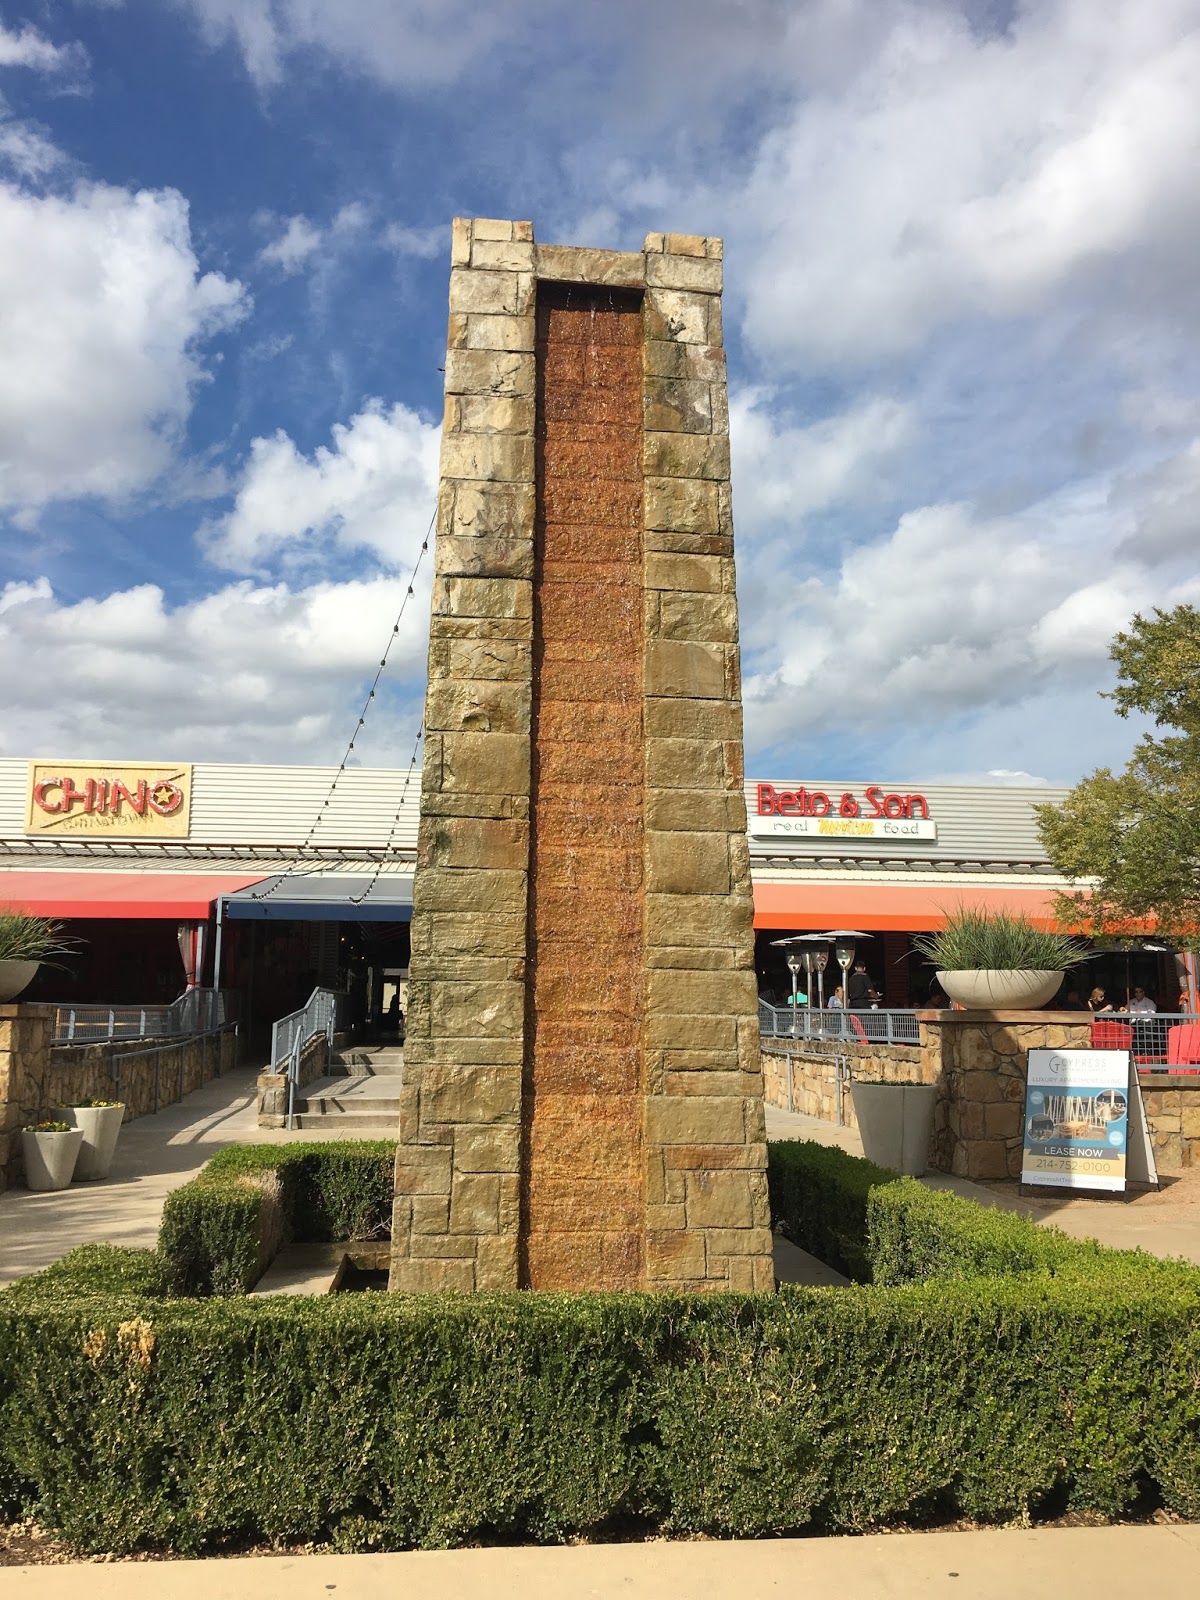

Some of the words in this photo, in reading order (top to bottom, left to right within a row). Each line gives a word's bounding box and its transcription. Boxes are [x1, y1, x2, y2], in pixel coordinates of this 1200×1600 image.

[34, 777, 182, 813] CHINO
[757, 784, 831, 816] Beto
[839, 793, 859, 817] &
[865, 786, 929, 818] Son
[773, 819, 808, 832] real
[883, 822, 919, 835] food
[1061, 1058, 1107, 1068] CYPRESS
[1044, 1146, 1075, 1156] LEASE
[1077, 1149, 1103, 1157] NOW
[1036, 1158, 1111, 1173] 214-752-0100
